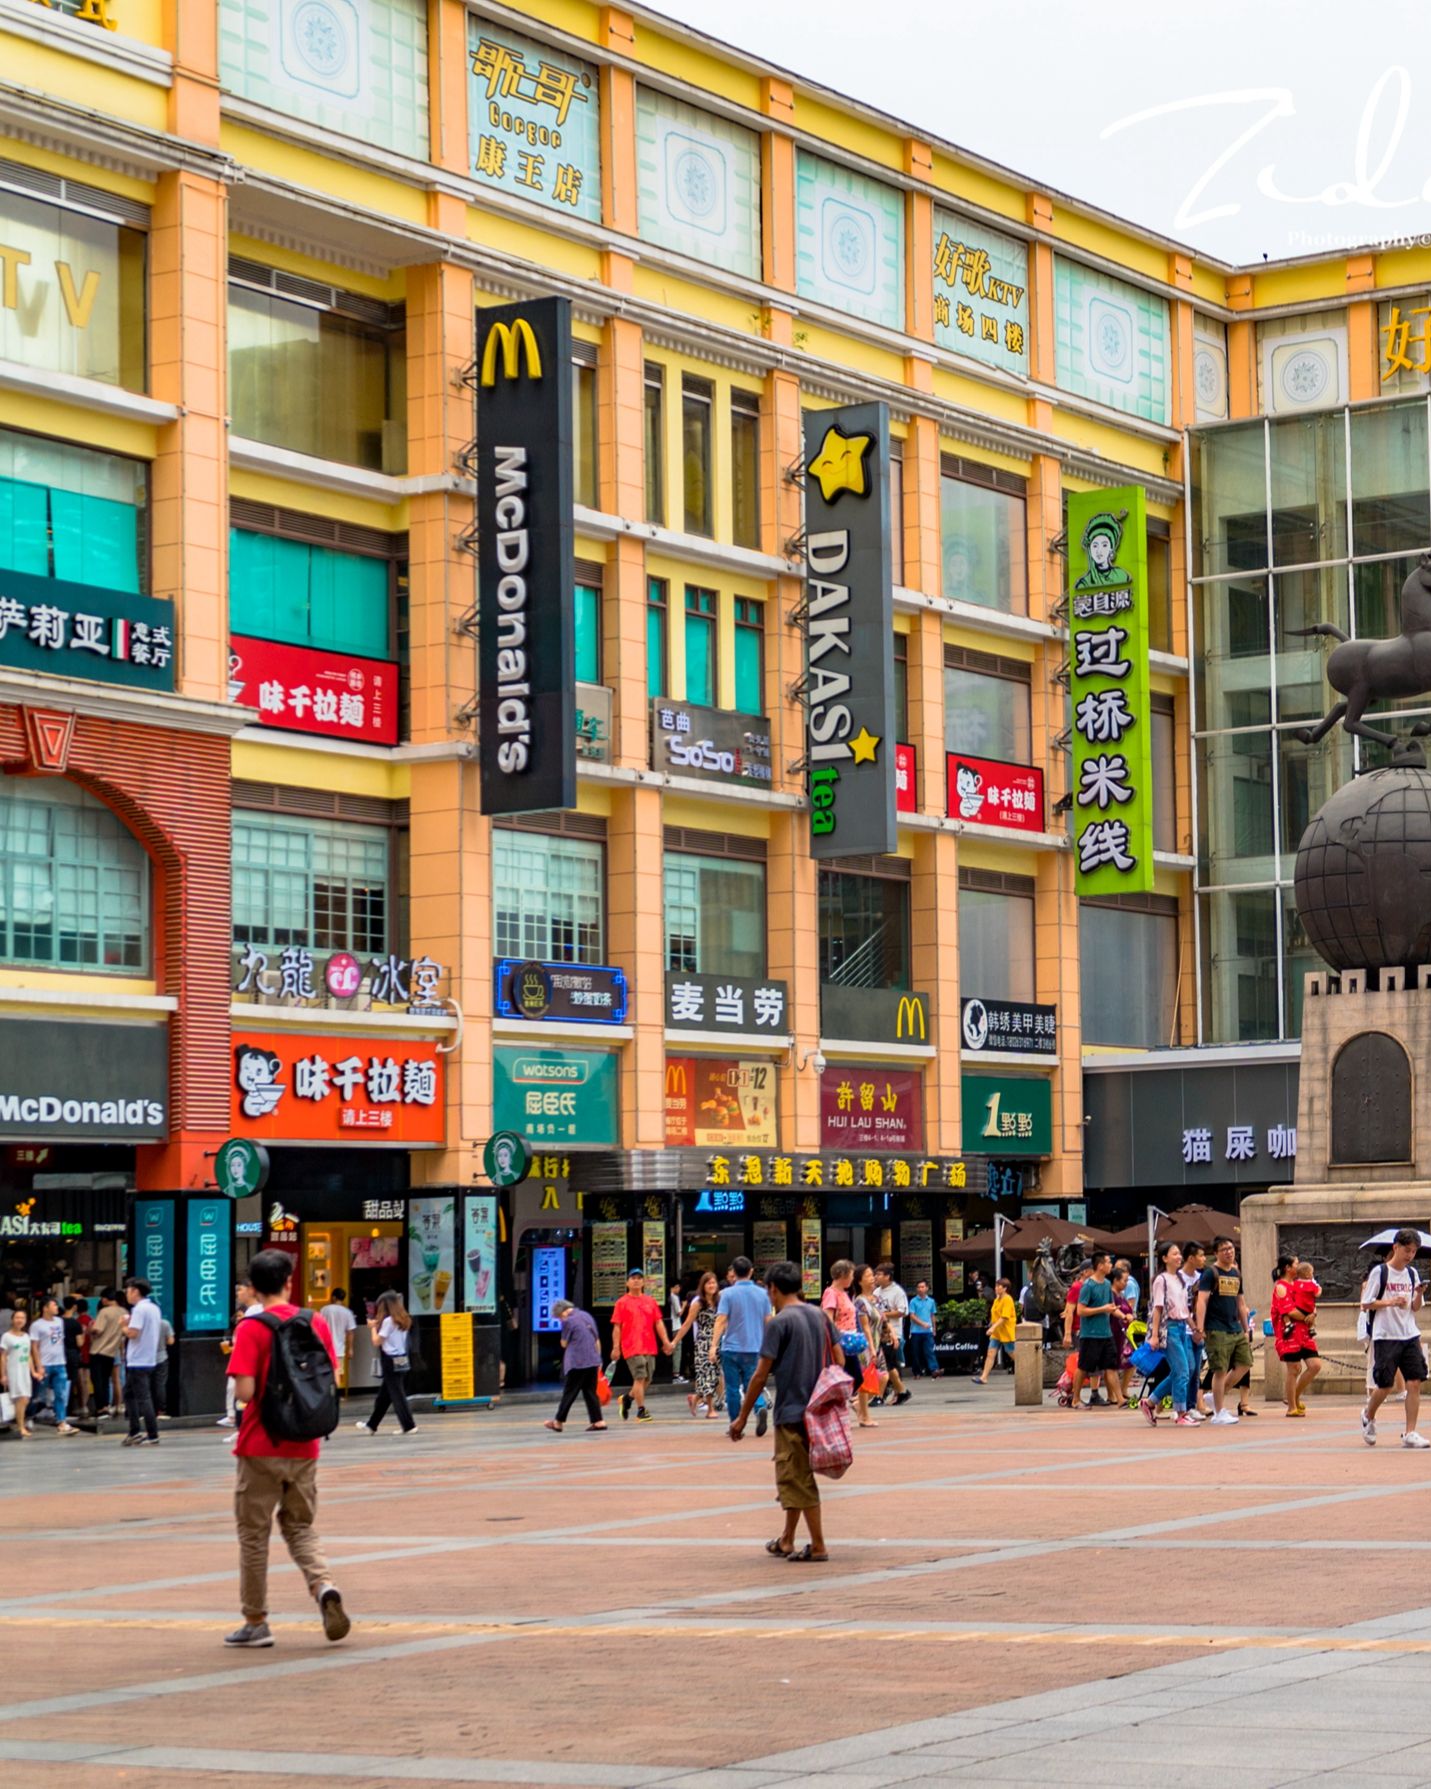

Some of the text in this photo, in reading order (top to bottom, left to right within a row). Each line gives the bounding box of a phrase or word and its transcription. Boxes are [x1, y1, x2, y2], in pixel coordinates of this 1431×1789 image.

[475, 134, 583, 207] 康王店
[934, 295, 1024, 346] 商场四楼
[494, 446, 528, 774] McDonald's
[131, 622, 172, 646] 意式
[131, 642, 171, 667] 餐厅
[807, 528, 852, 762] DAKASI
[1075, 629, 1136, 874] 过桥米线
[810, 766, 837, 836] tea
[671, 981, 784, 1027] 麦当劳
[0, 1096, 164, 1126] McDonald's
[342, 1109, 393, 1128] 请上三楼
[526, 1091, 576, 1116] 屈臣氏
[851, 1117, 871, 1128] LAU
[875, 1117, 904, 1129] SHAN
[1182, 1123, 1297, 1162] 猫屎咖
